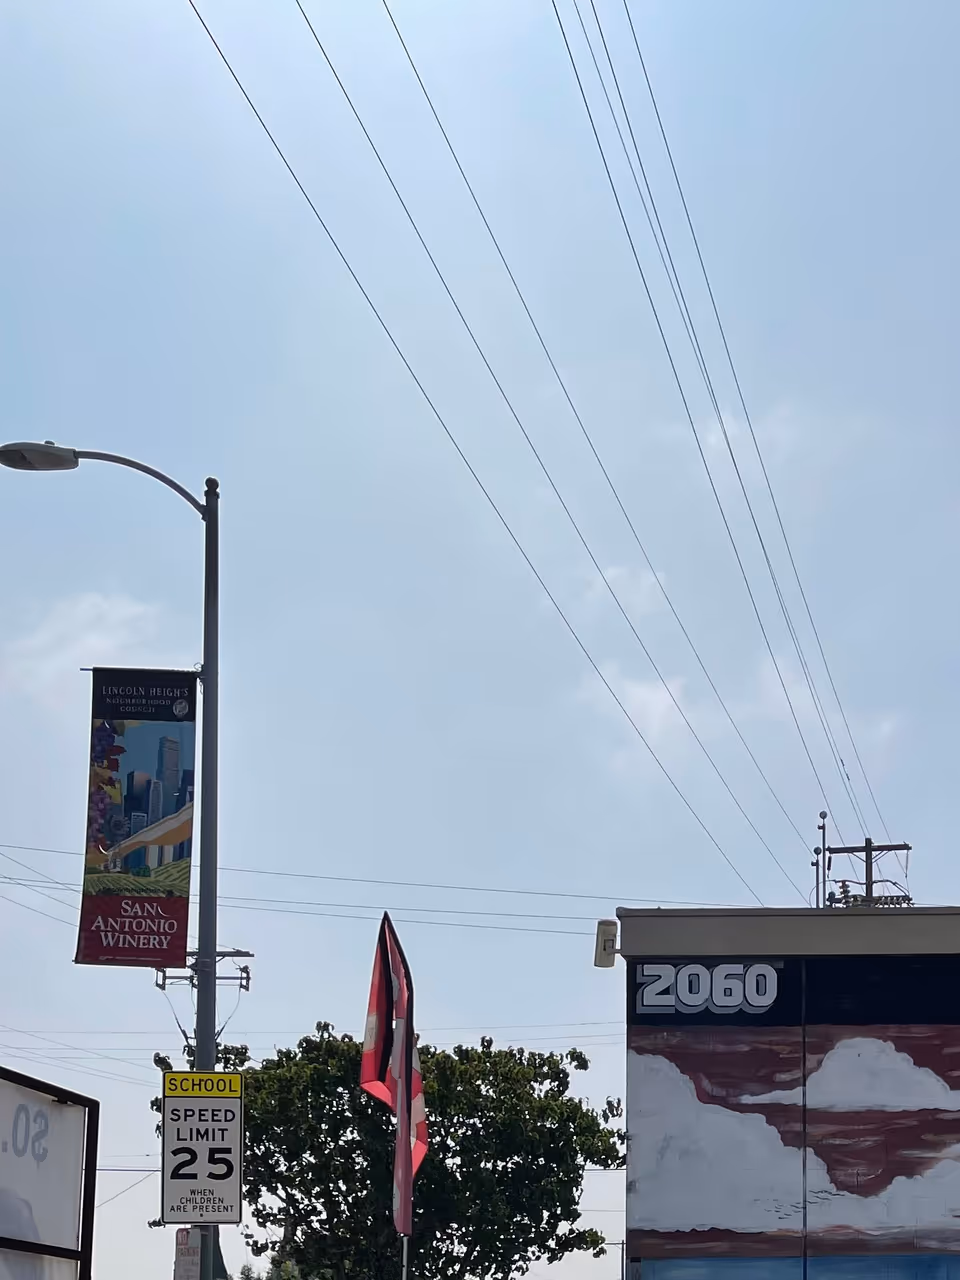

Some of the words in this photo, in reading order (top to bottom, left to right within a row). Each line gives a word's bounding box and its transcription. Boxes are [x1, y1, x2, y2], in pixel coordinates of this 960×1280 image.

[102, 685, 145, 696] LINCOLN
[120, 899, 158, 916] SAN
[91, 915, 178, 933] ANTONIO
[100, 931, 171, 949] WINERY
[635, 963, 779, 1014] 2060
[168, 1077, 238, 1093] SCHOOL
[169, 1108, 236, 1123] SPEED
[176, 1127, 229, 1142] LIMIT
[169, 1146, 235, 1181] 25
[189, 1188, 215, 1197] WHEN
[179, 1197, 225, 1205] CHILDREN
[169, 1205, 189, 1213] ARE
[192, 1205, 235, 1213] PRESENT
